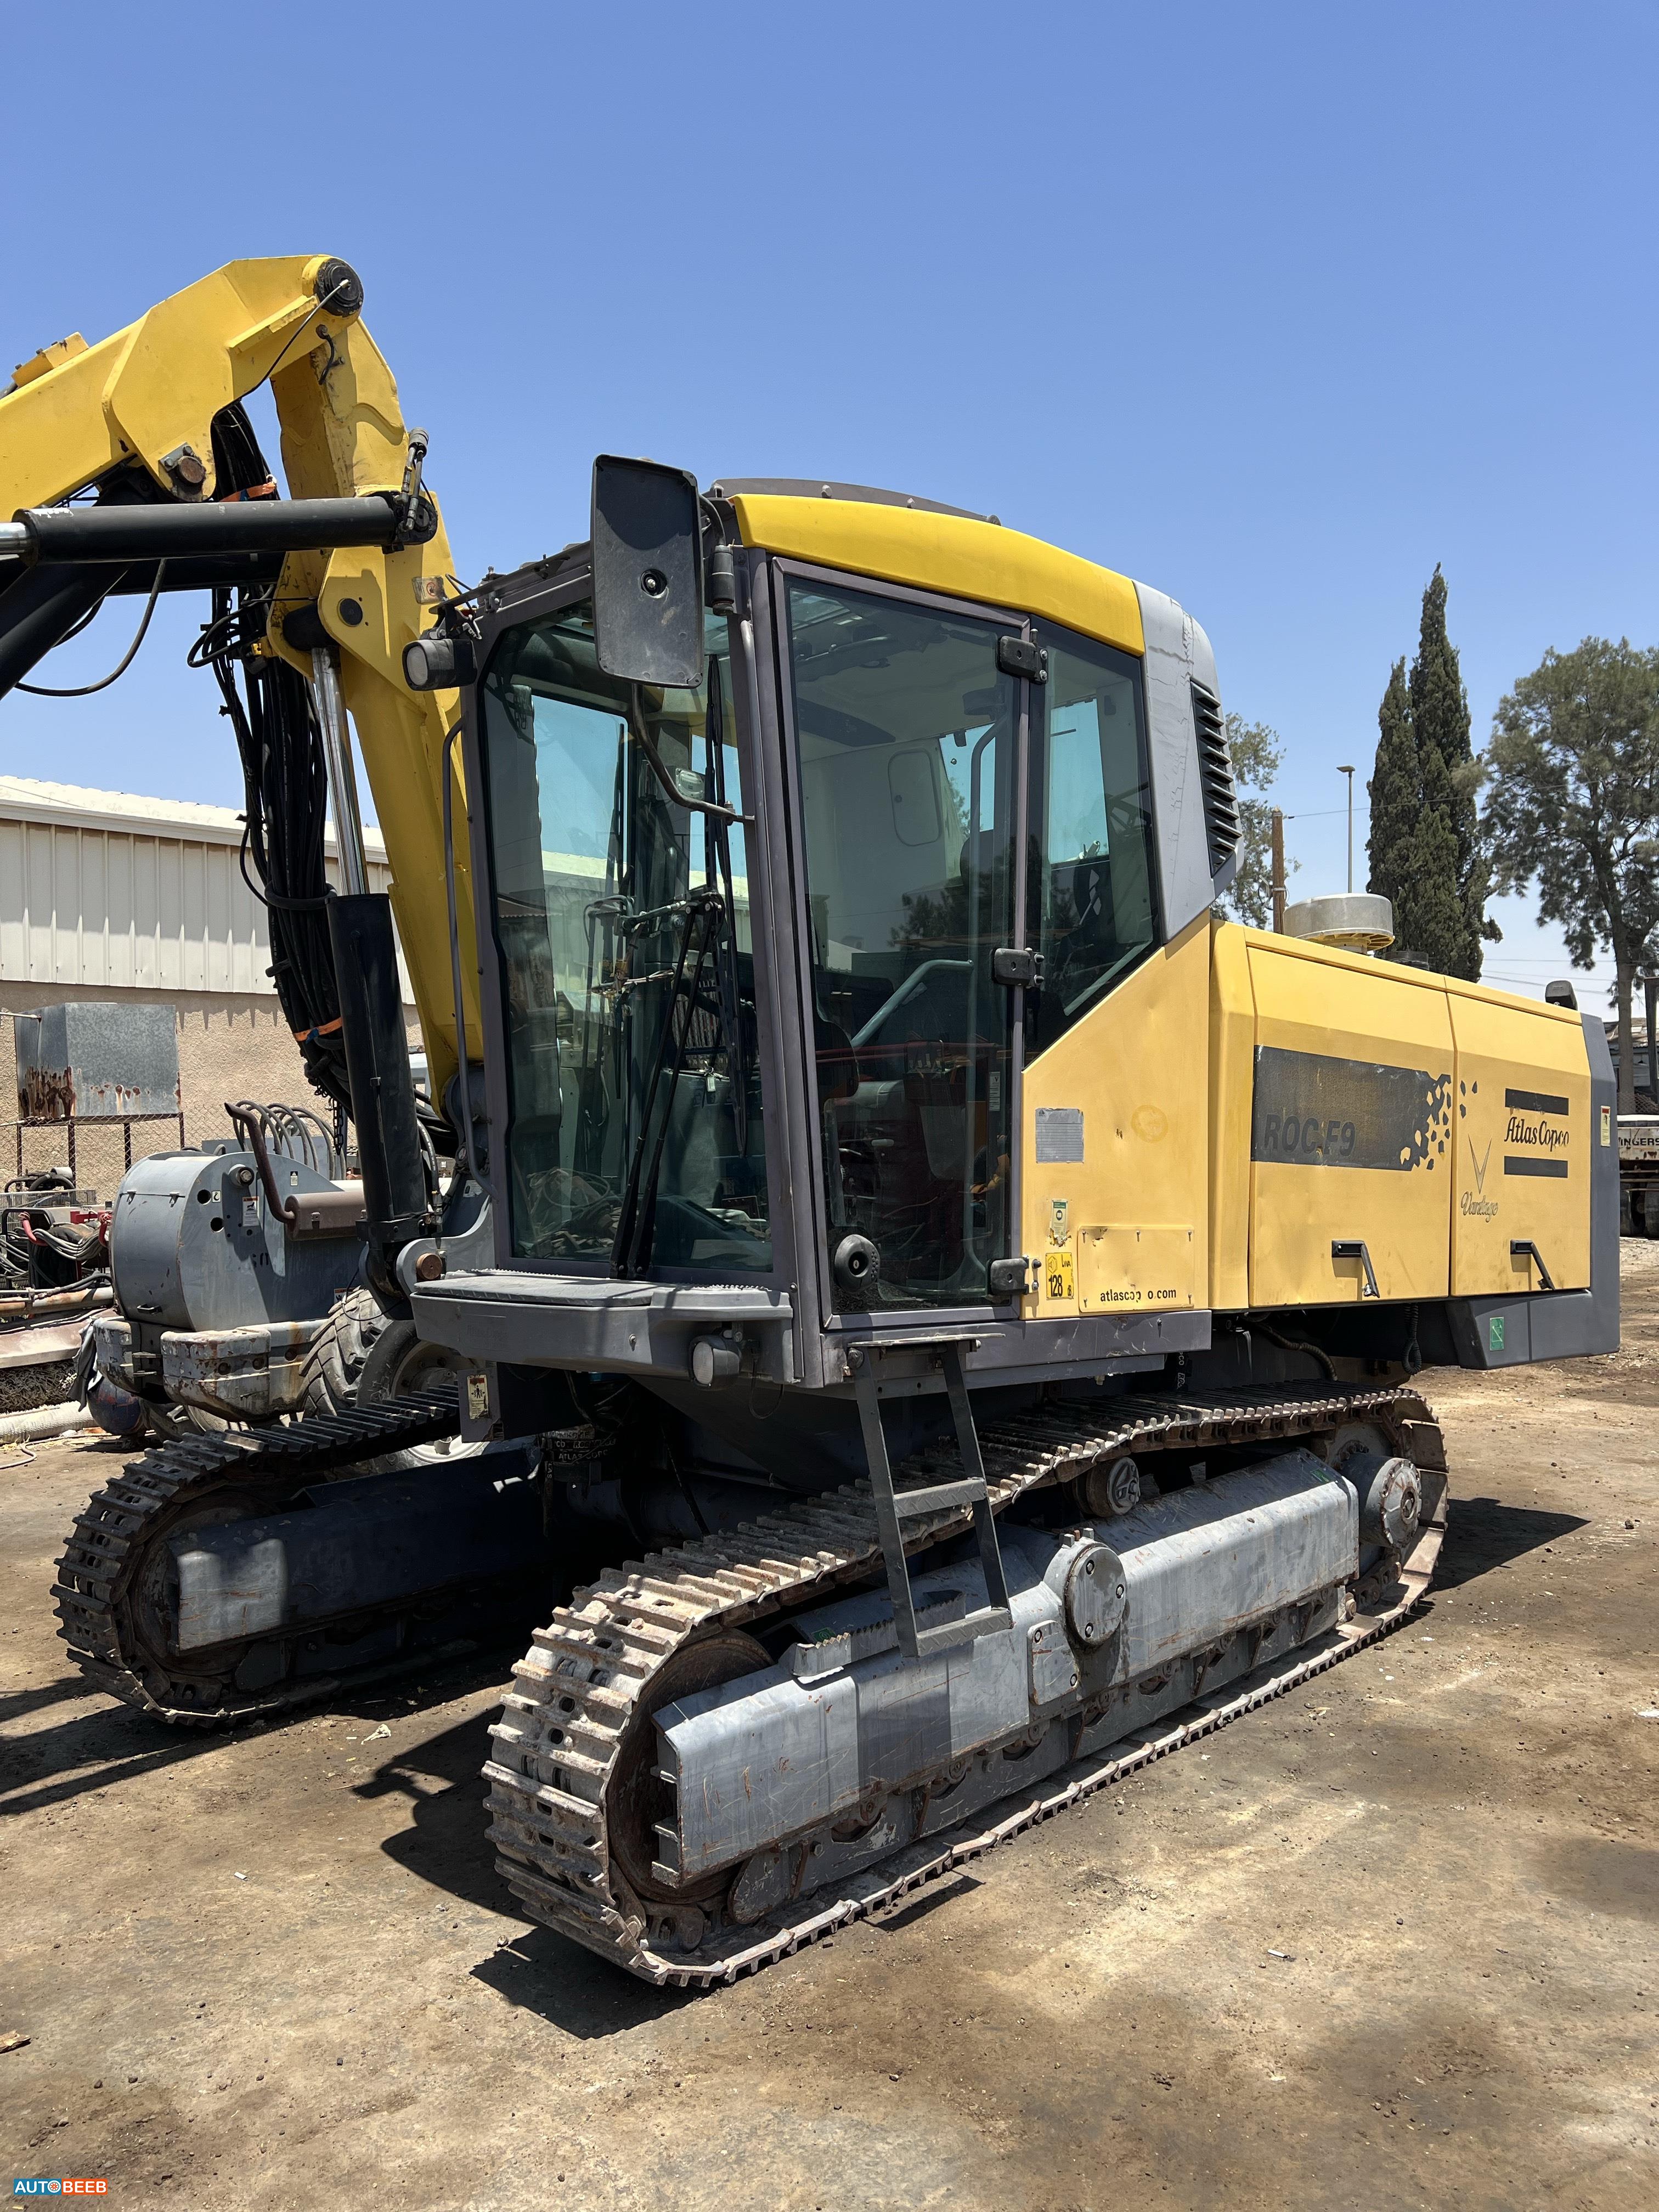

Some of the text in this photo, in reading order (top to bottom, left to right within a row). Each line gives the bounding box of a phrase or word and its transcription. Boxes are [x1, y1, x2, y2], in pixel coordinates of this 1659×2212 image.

[1263, 1114, 1356, 1157] ROC F9
[1504, 1116, 1538, 1144] Atlas
[1539, 1120, 1570, 1152] Copco
[1460, 1191, 1498, 1223] Vantage
[1048, 1274, 1063, 1297] 128
[1100, 1289, 1176, 1303] atlascopo.com
